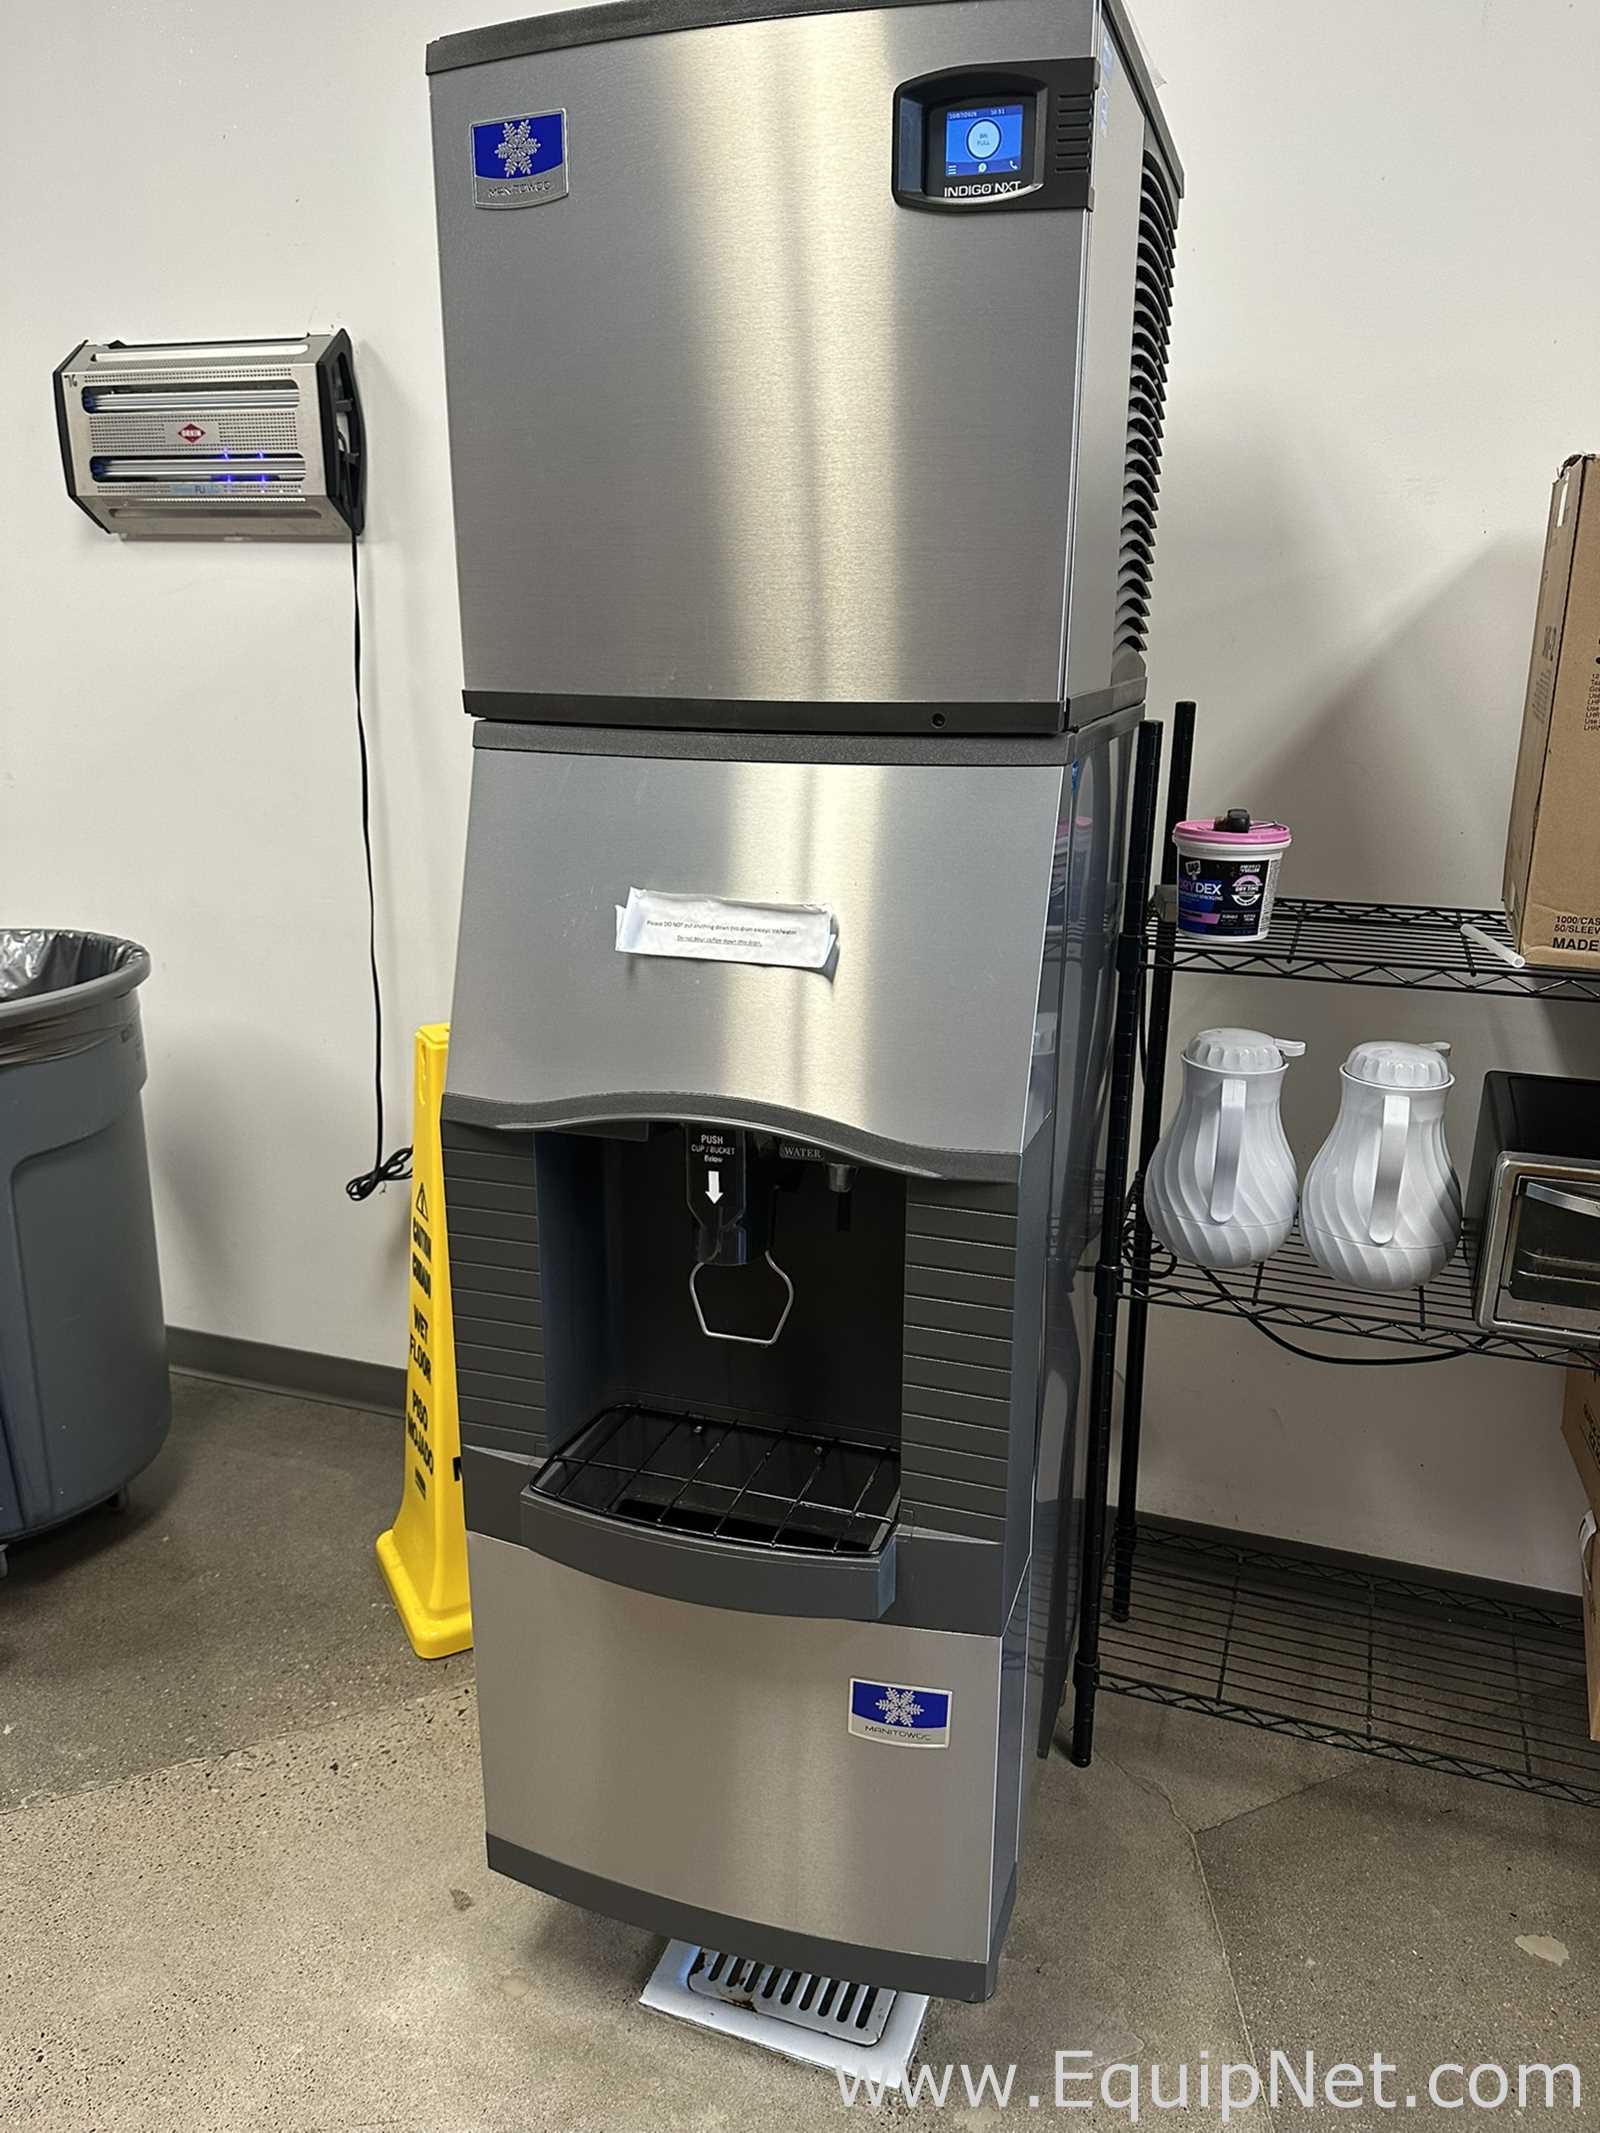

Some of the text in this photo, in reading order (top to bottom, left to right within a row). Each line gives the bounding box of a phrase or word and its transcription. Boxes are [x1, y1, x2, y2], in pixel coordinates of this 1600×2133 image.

[944, 180, 1022, 198] INDIGO NXT
[664, 920, 673, 928] DO
[1552, 936, 1600, 952] MADE
[700, 1134, 724, 1145] PUSH
[710, 1146, 735, 1155] BUCKET
[784, 1145, 822, 1159] WATER
[413, 1304, 428, 1345] WET
[410, 1333, 432, 1385] FLOOR
[864, 1725, 932, 1741] MANITOWOC
